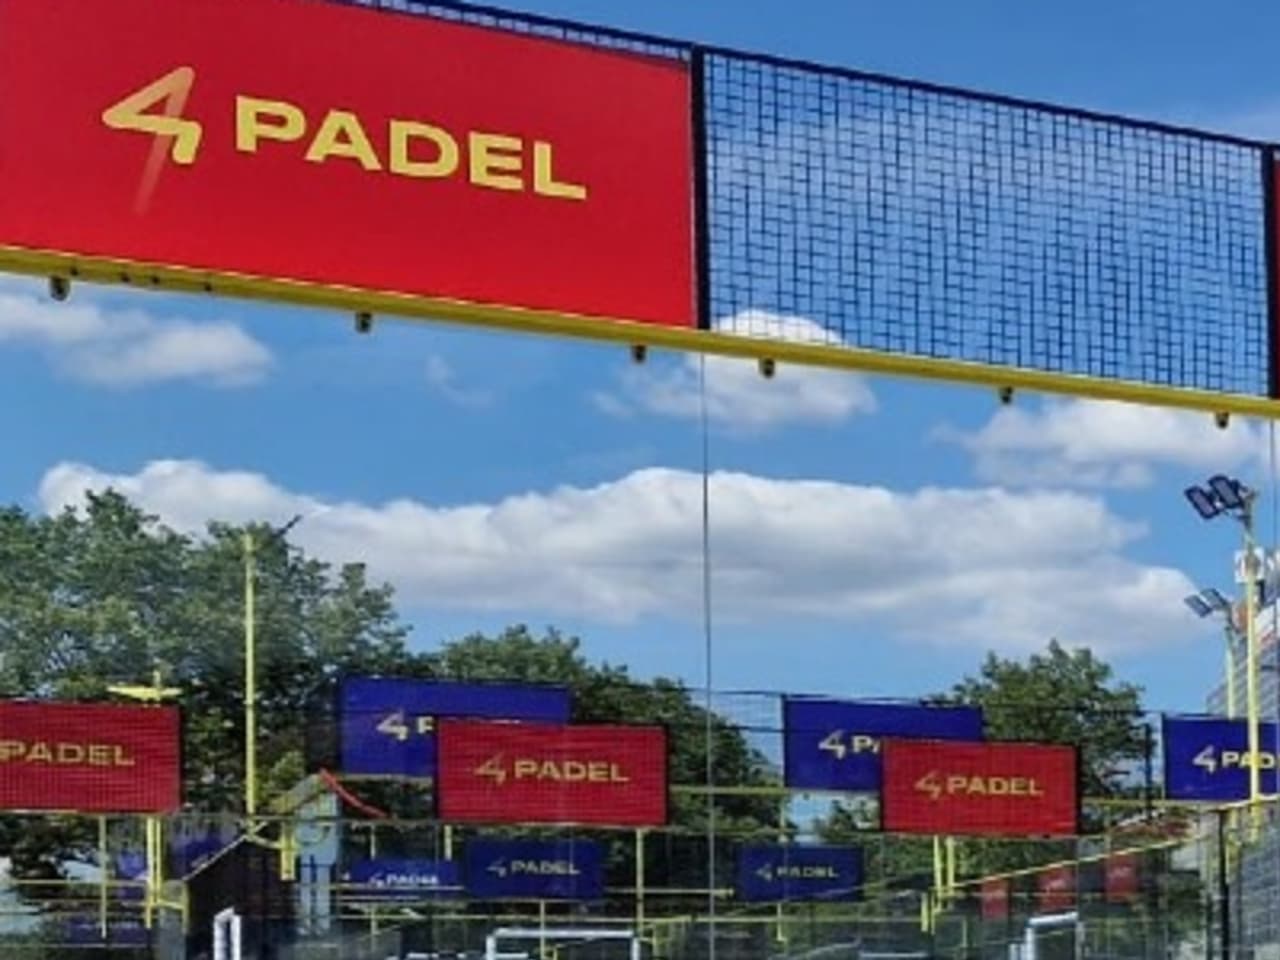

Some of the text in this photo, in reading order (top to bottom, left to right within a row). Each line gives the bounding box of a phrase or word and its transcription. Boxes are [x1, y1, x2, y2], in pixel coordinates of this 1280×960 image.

[102, 66, 587, 212] 4 PADEL
[0, 740, 135, 766] PADEL
[514, 760, 629, 782] PADEL
[946, 776, 1043, 796] PADEL
[511, 860, 580, 875] PADEL
